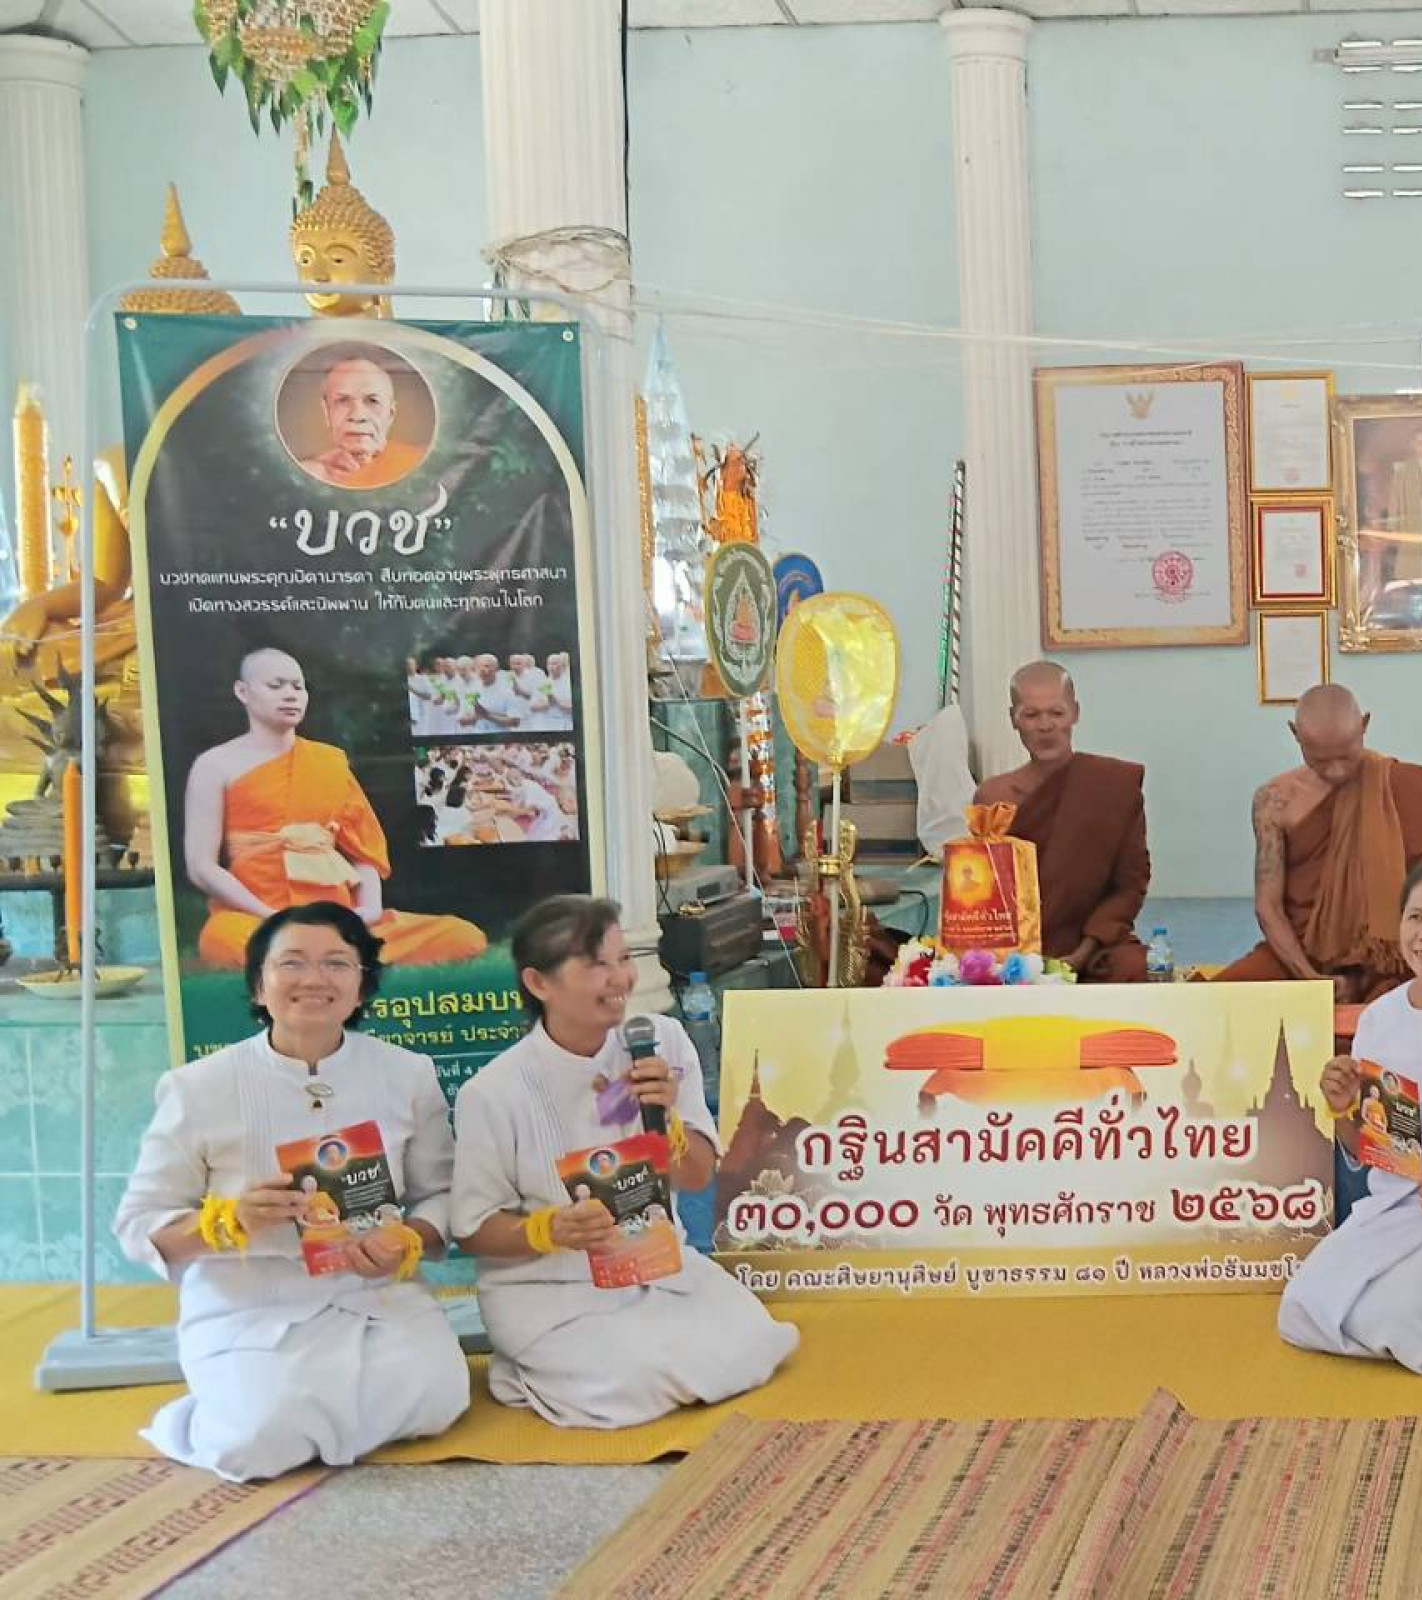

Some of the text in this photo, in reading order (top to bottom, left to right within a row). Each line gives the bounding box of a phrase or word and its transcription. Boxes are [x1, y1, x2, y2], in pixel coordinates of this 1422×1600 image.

[803, 1093, 1253, 1181] กฐินสามัคคีทั่วไทย
[735, 1185, 1317, 1237] ๓๐,๐๐๐ วัด พุทธศักราช ๒๕๖๘
[739, 1266, 778, 1287] โดย
[788, 1262, 957, 1291] คณะศิษยานุศิษย์
[967, 1265, 1067, 1291] บูชาธรรม
[1075, 1268, 1106, 1282] ๘๑
[1115, 1259, 1130, 1281] ปี
